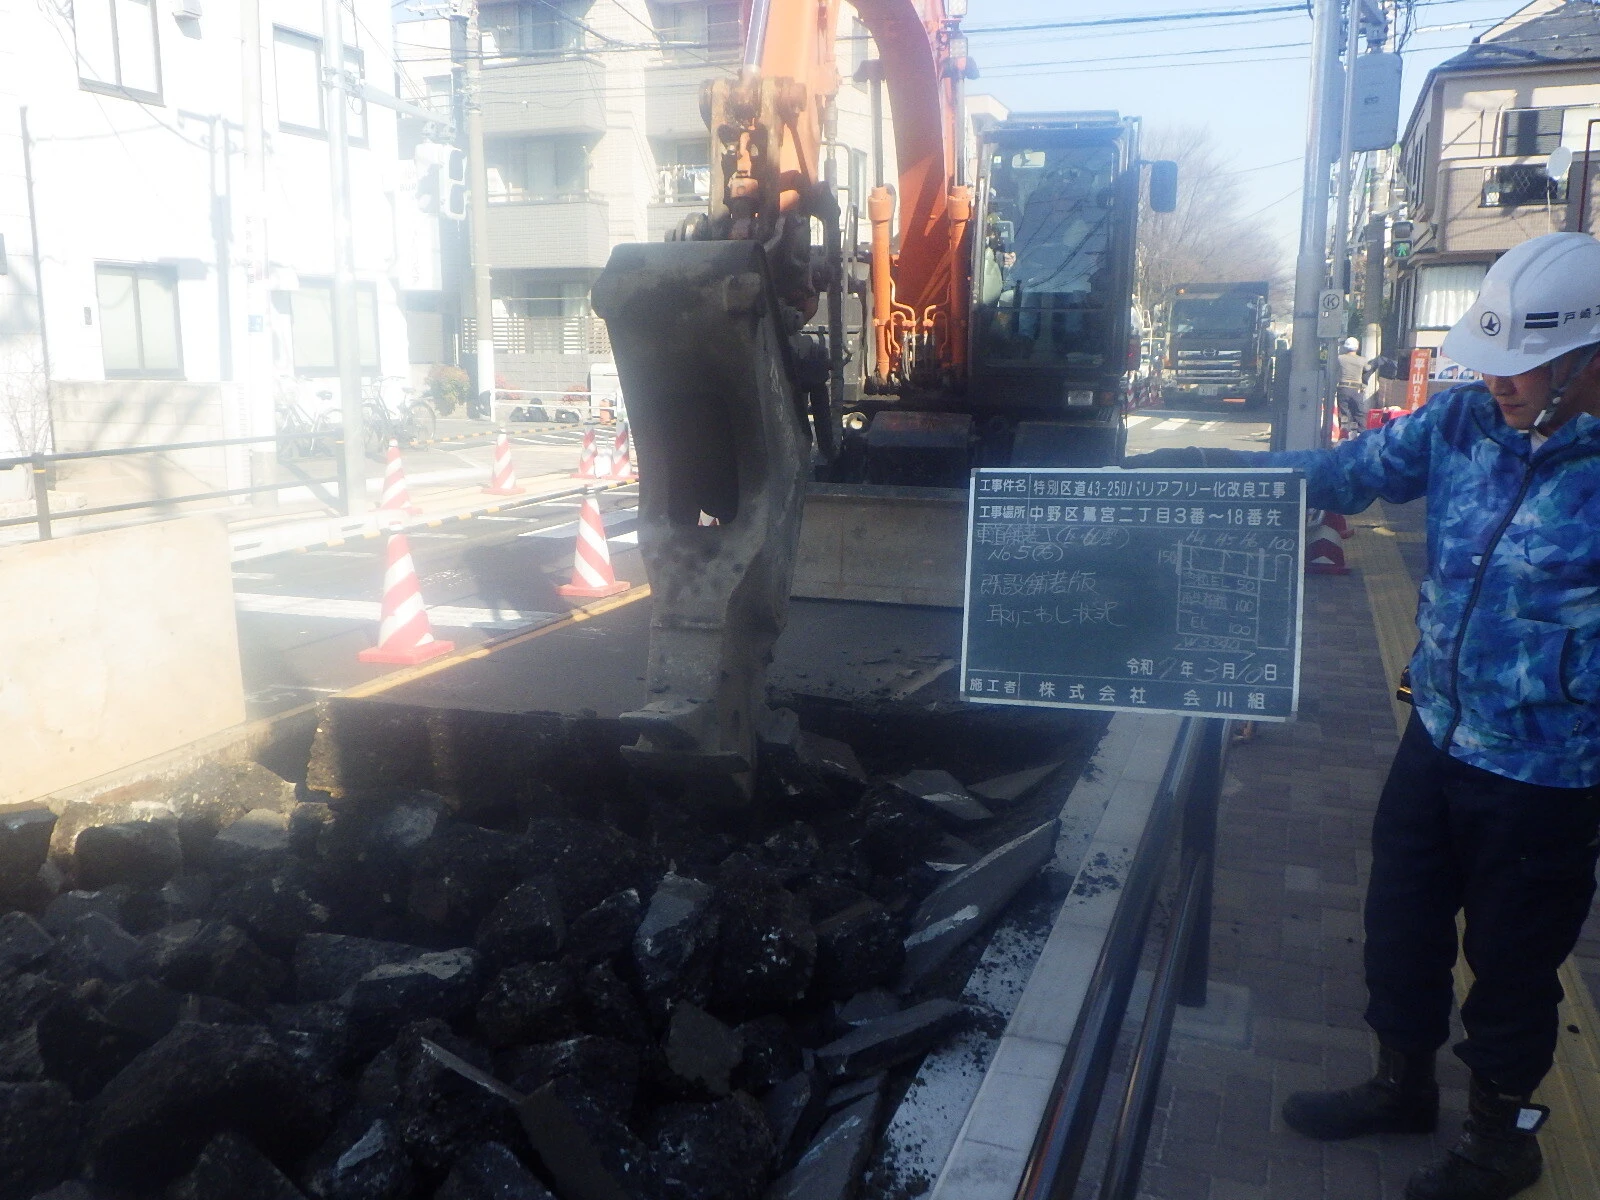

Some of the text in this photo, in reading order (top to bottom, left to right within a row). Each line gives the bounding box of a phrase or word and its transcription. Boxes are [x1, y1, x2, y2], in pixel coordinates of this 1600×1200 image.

[980, 479, 1027, 493] 工事件名
[979, 506, 1026, 519] 工事場所
[969, 677, 1017, 693] 施工者
